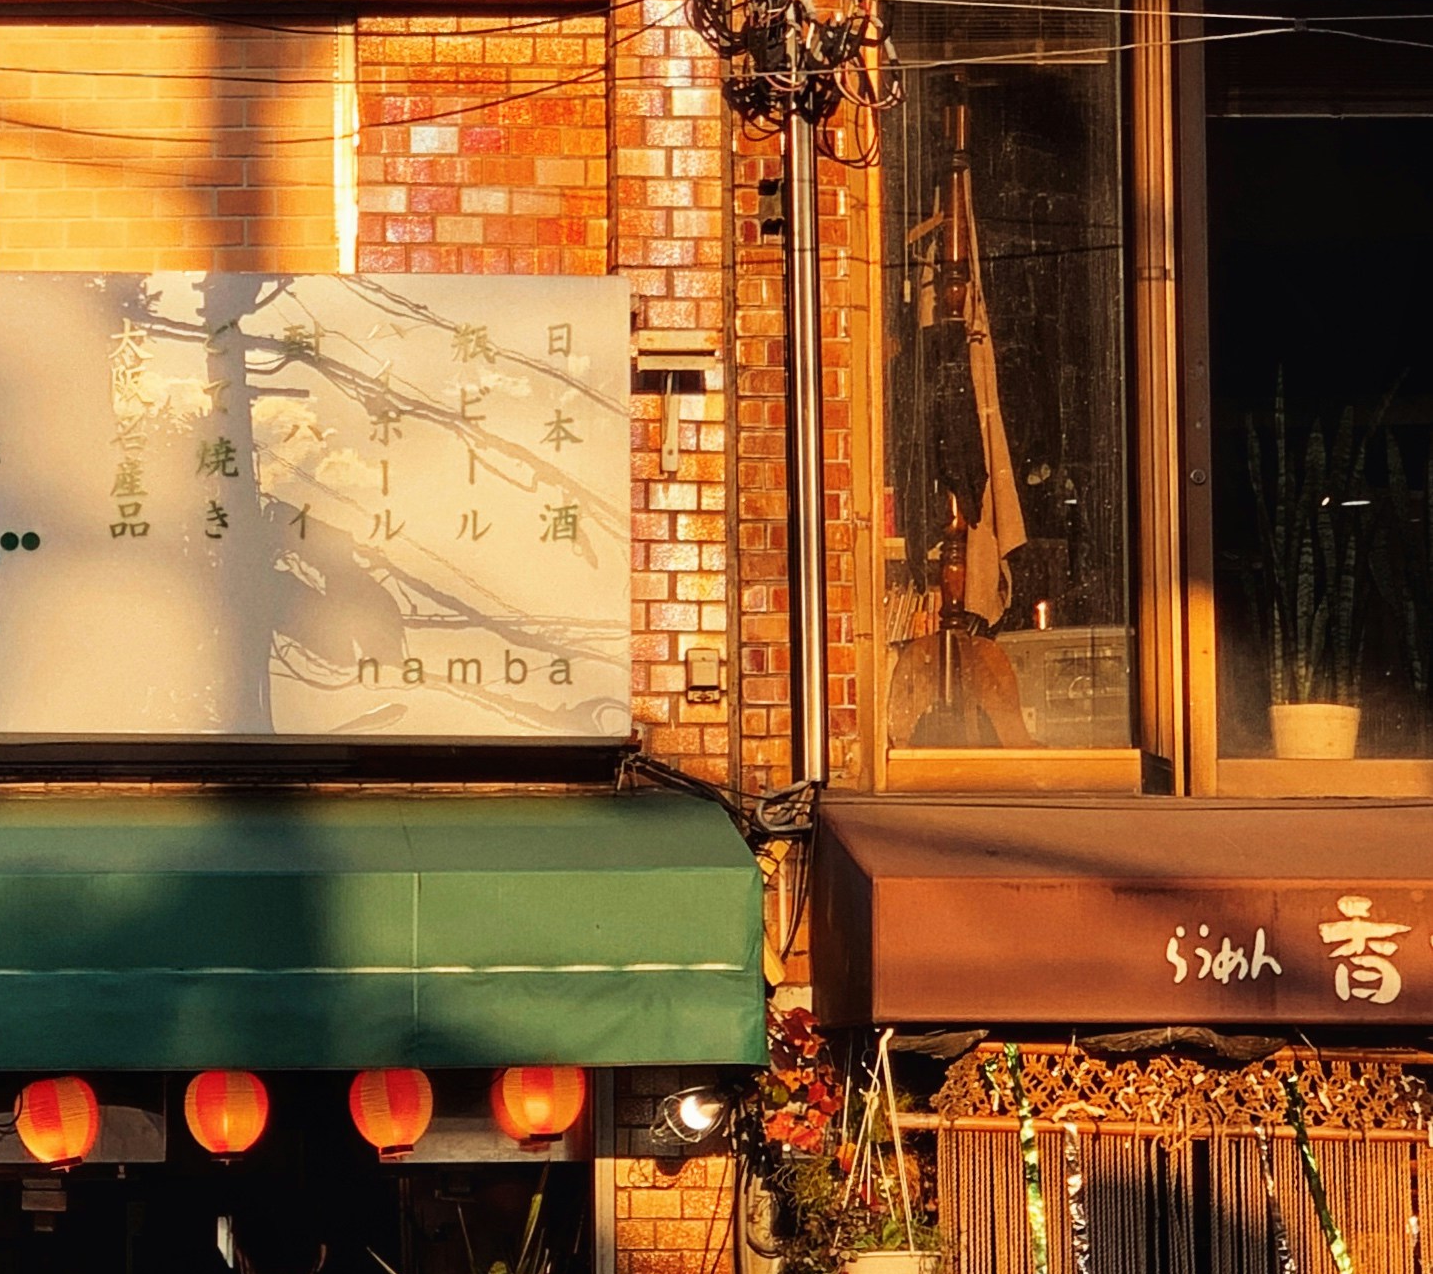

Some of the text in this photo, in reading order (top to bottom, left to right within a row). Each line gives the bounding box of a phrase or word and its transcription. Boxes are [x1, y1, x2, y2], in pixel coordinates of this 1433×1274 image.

[107, 316, 154, 541] 大阪名産品
[451, 321, 496, 543] 瓶ビール
[538, 322, 584, 544] 日本酒
[356, 647, 575, 687] namba
[1318, 895, 1413, 1004] 香
